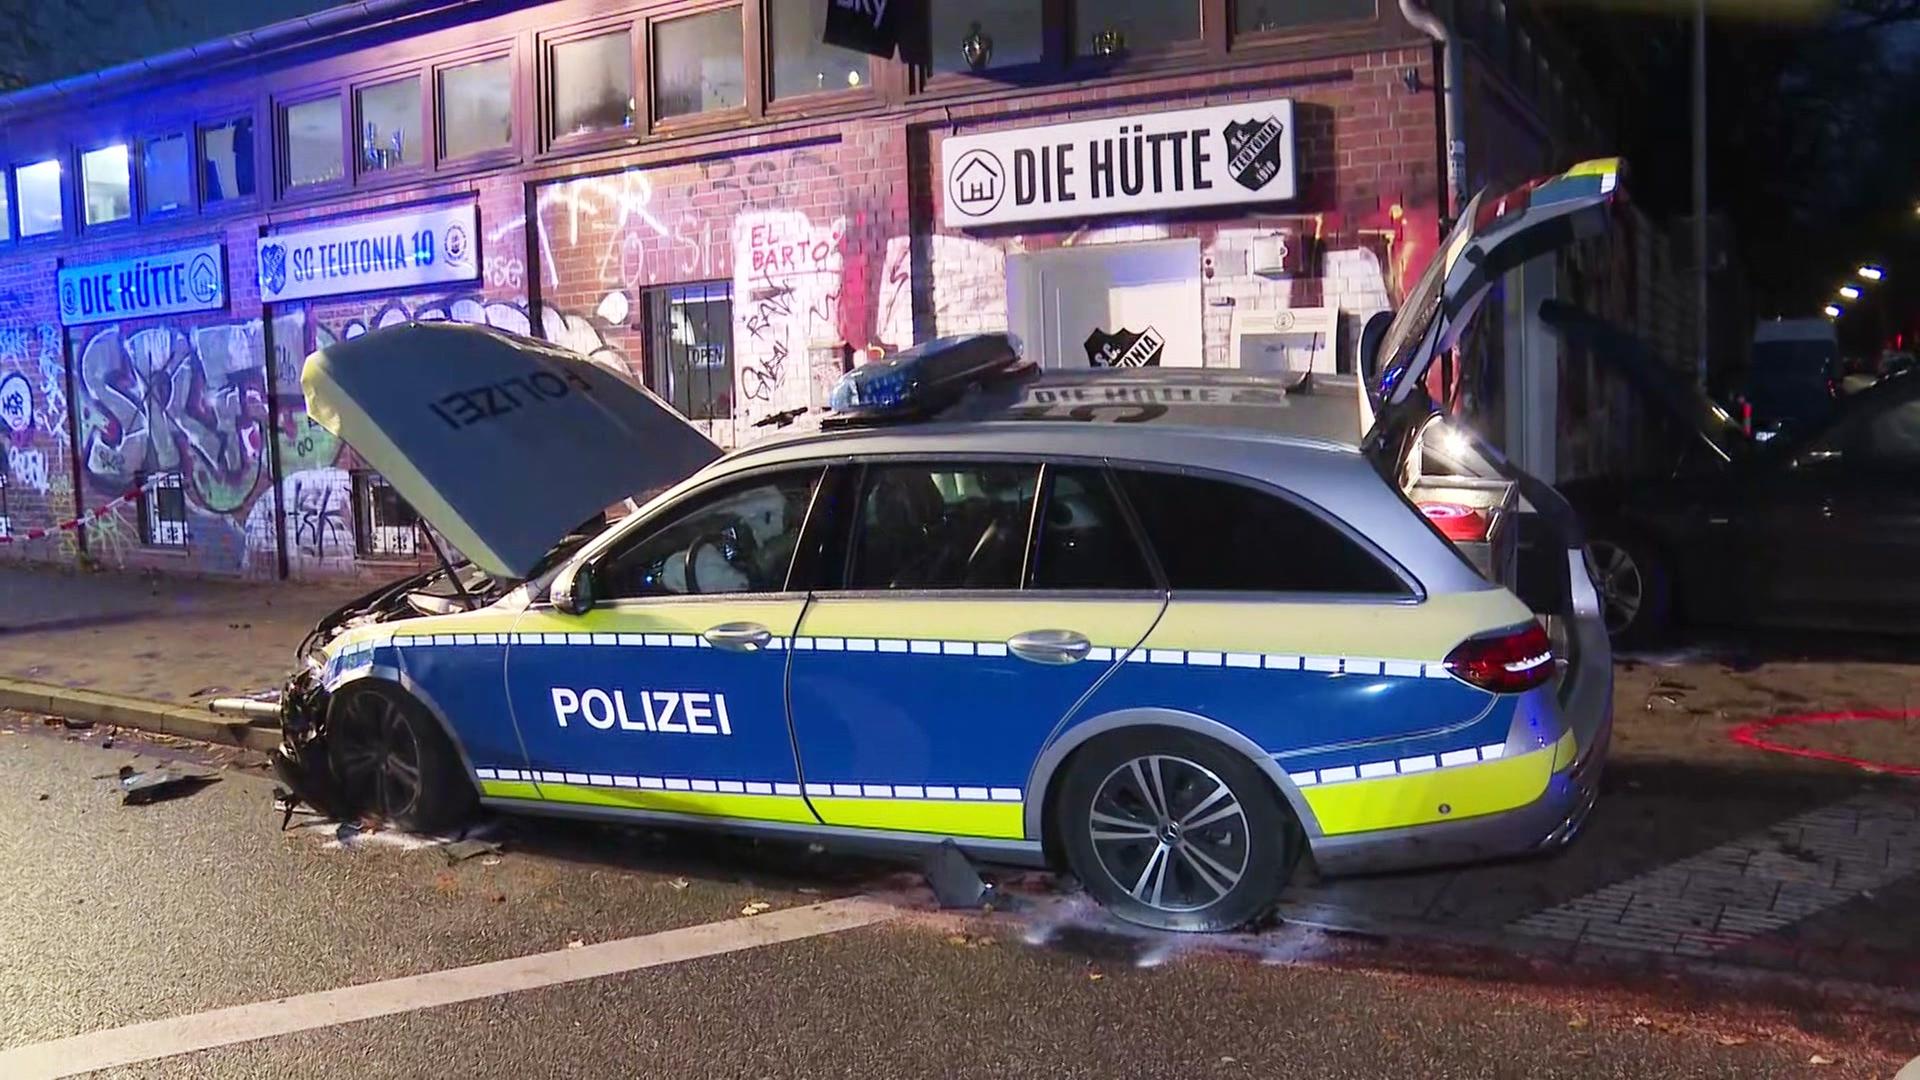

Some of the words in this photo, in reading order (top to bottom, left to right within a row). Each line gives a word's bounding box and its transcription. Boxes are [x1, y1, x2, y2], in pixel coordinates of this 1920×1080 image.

[1014, 143, 1076, 205] DIE
[1089, 124, 1213, 198] HÜTTE
[1231, 121, 1278, 172] TEUTONIA
[293, 246, 315, 282] SC
[318, 233, 408, 280] TEUTONIA
[751, 223, 779, 249] EL
[752, 240, 830, 271] BARTO
[79, 273, 115, 316] DIE
[118, 260, 188, 311] HÜTTE
[692, 347, 723, 364] OPEN
[551, 687, 732, 736] POLIZEI
